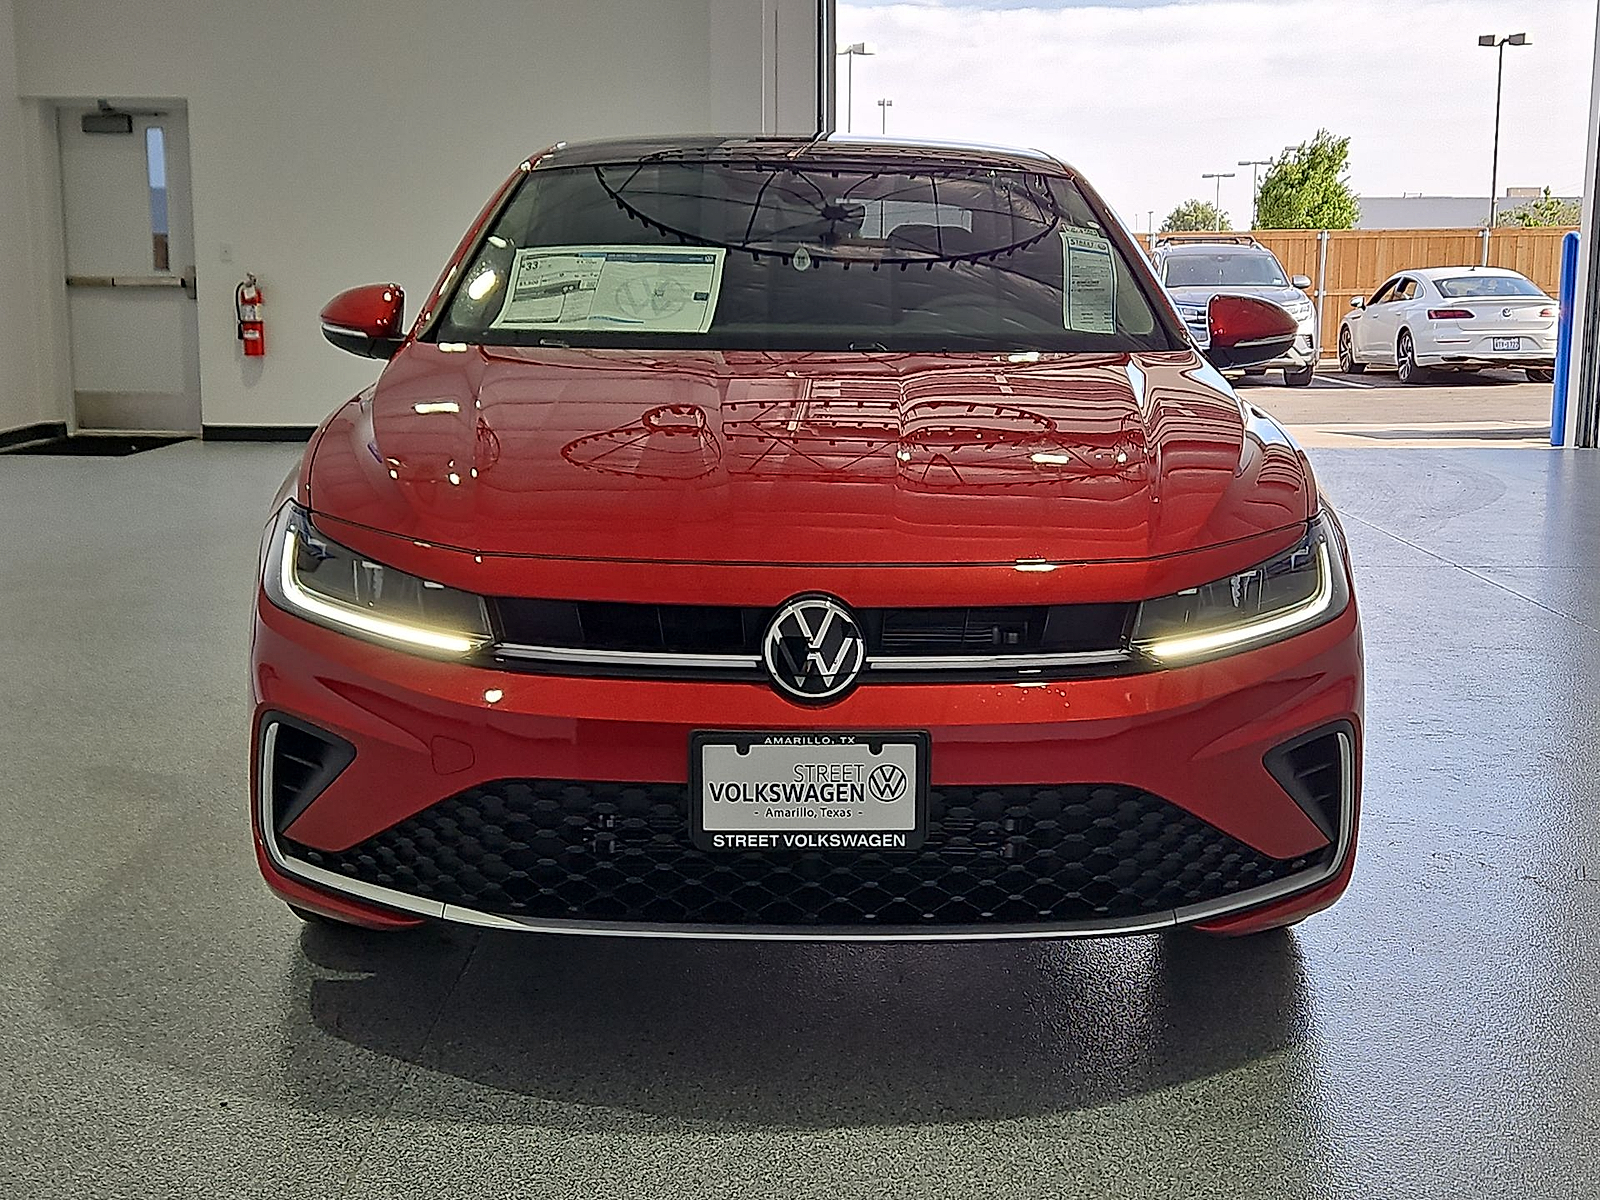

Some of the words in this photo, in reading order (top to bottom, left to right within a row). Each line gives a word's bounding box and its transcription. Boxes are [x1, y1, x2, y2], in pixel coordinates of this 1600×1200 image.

[840, 736, 856, 744] TX
[793, 764, 865, 783] STREET
[709, 783, 865, 803] VOLKSWAGEN
[765, 807, 818, 819] Amarillo,
[821, 807, 852, 818] Texas
[713, 834, 779, 848] STREET
[784, 834, 906, 848] VOLKSWAGEN
